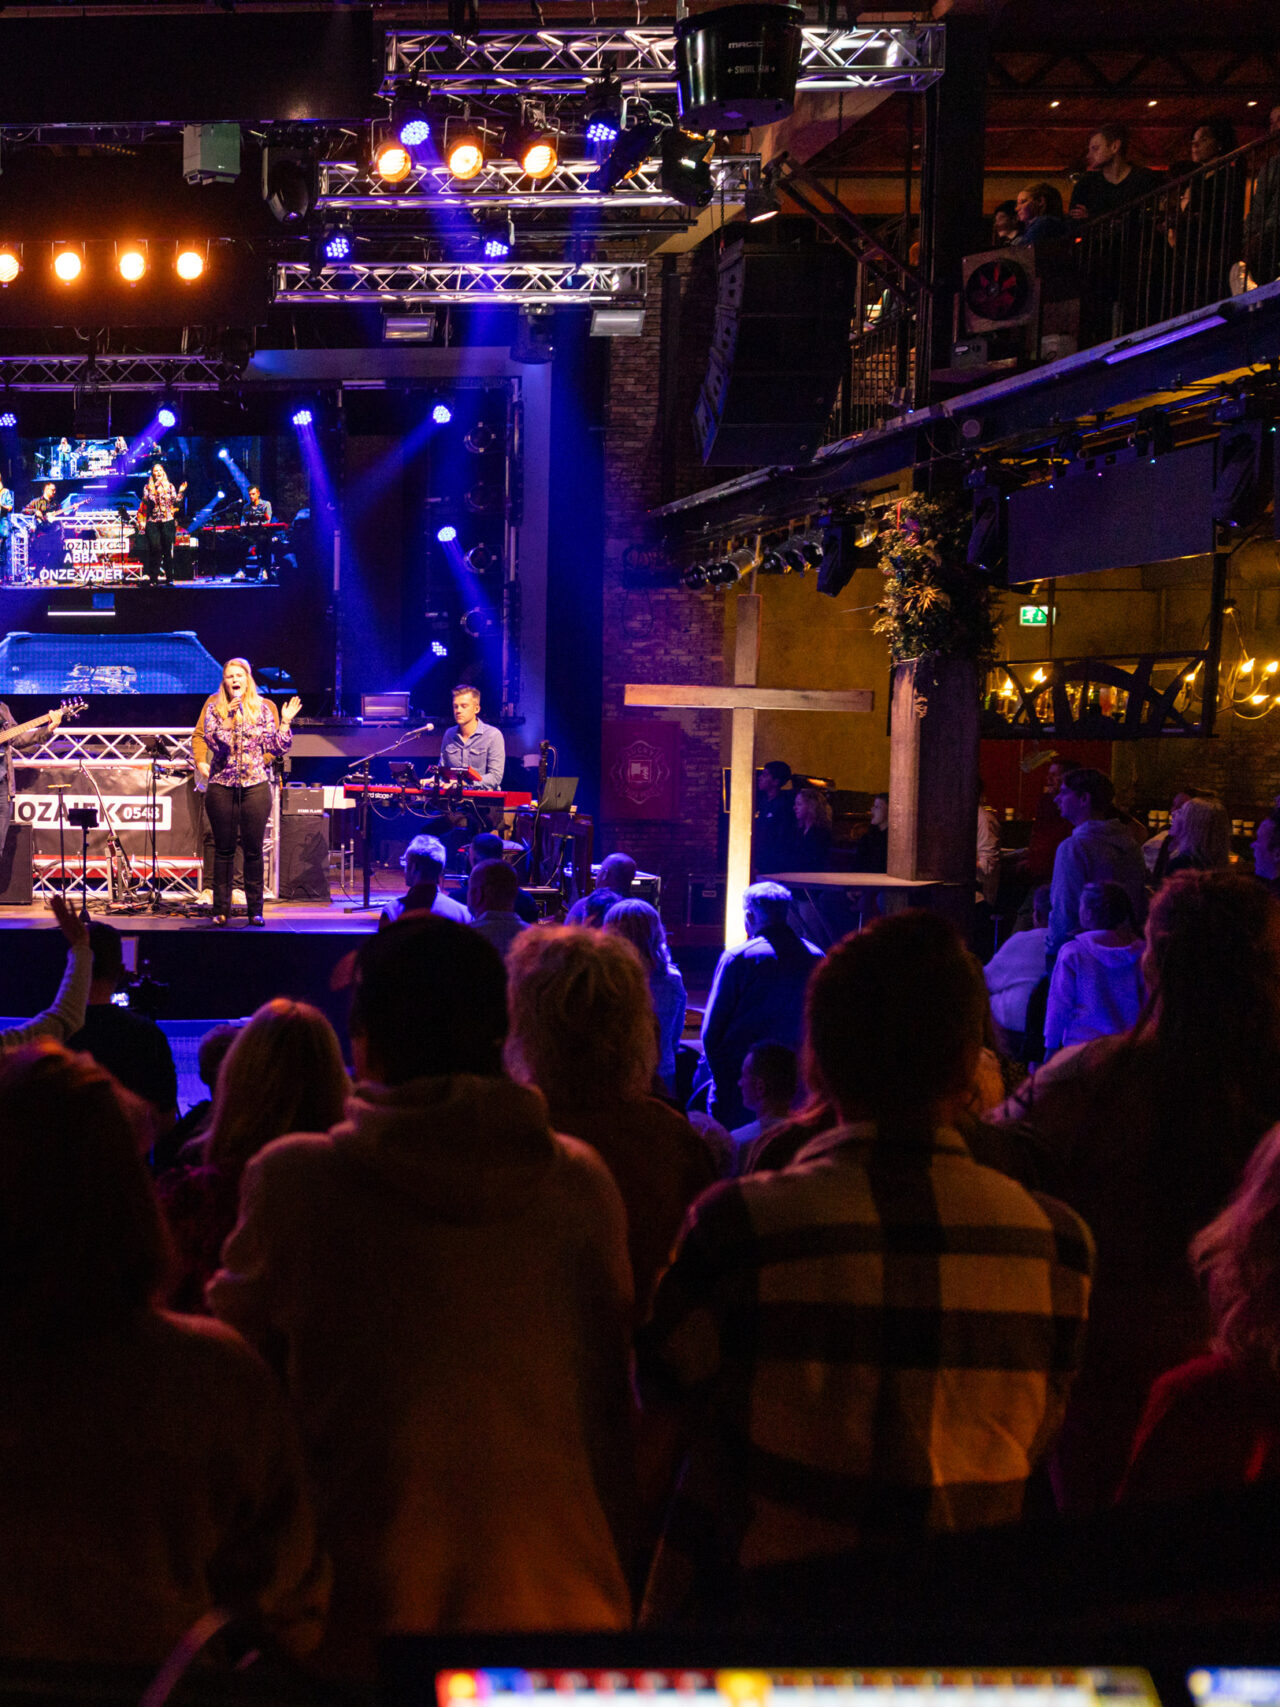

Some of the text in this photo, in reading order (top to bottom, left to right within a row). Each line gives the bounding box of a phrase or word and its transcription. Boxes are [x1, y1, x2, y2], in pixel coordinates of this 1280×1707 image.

[63, 552, 99, 563] ABBA
[39, 568, 123, 580] ONZE VADER
